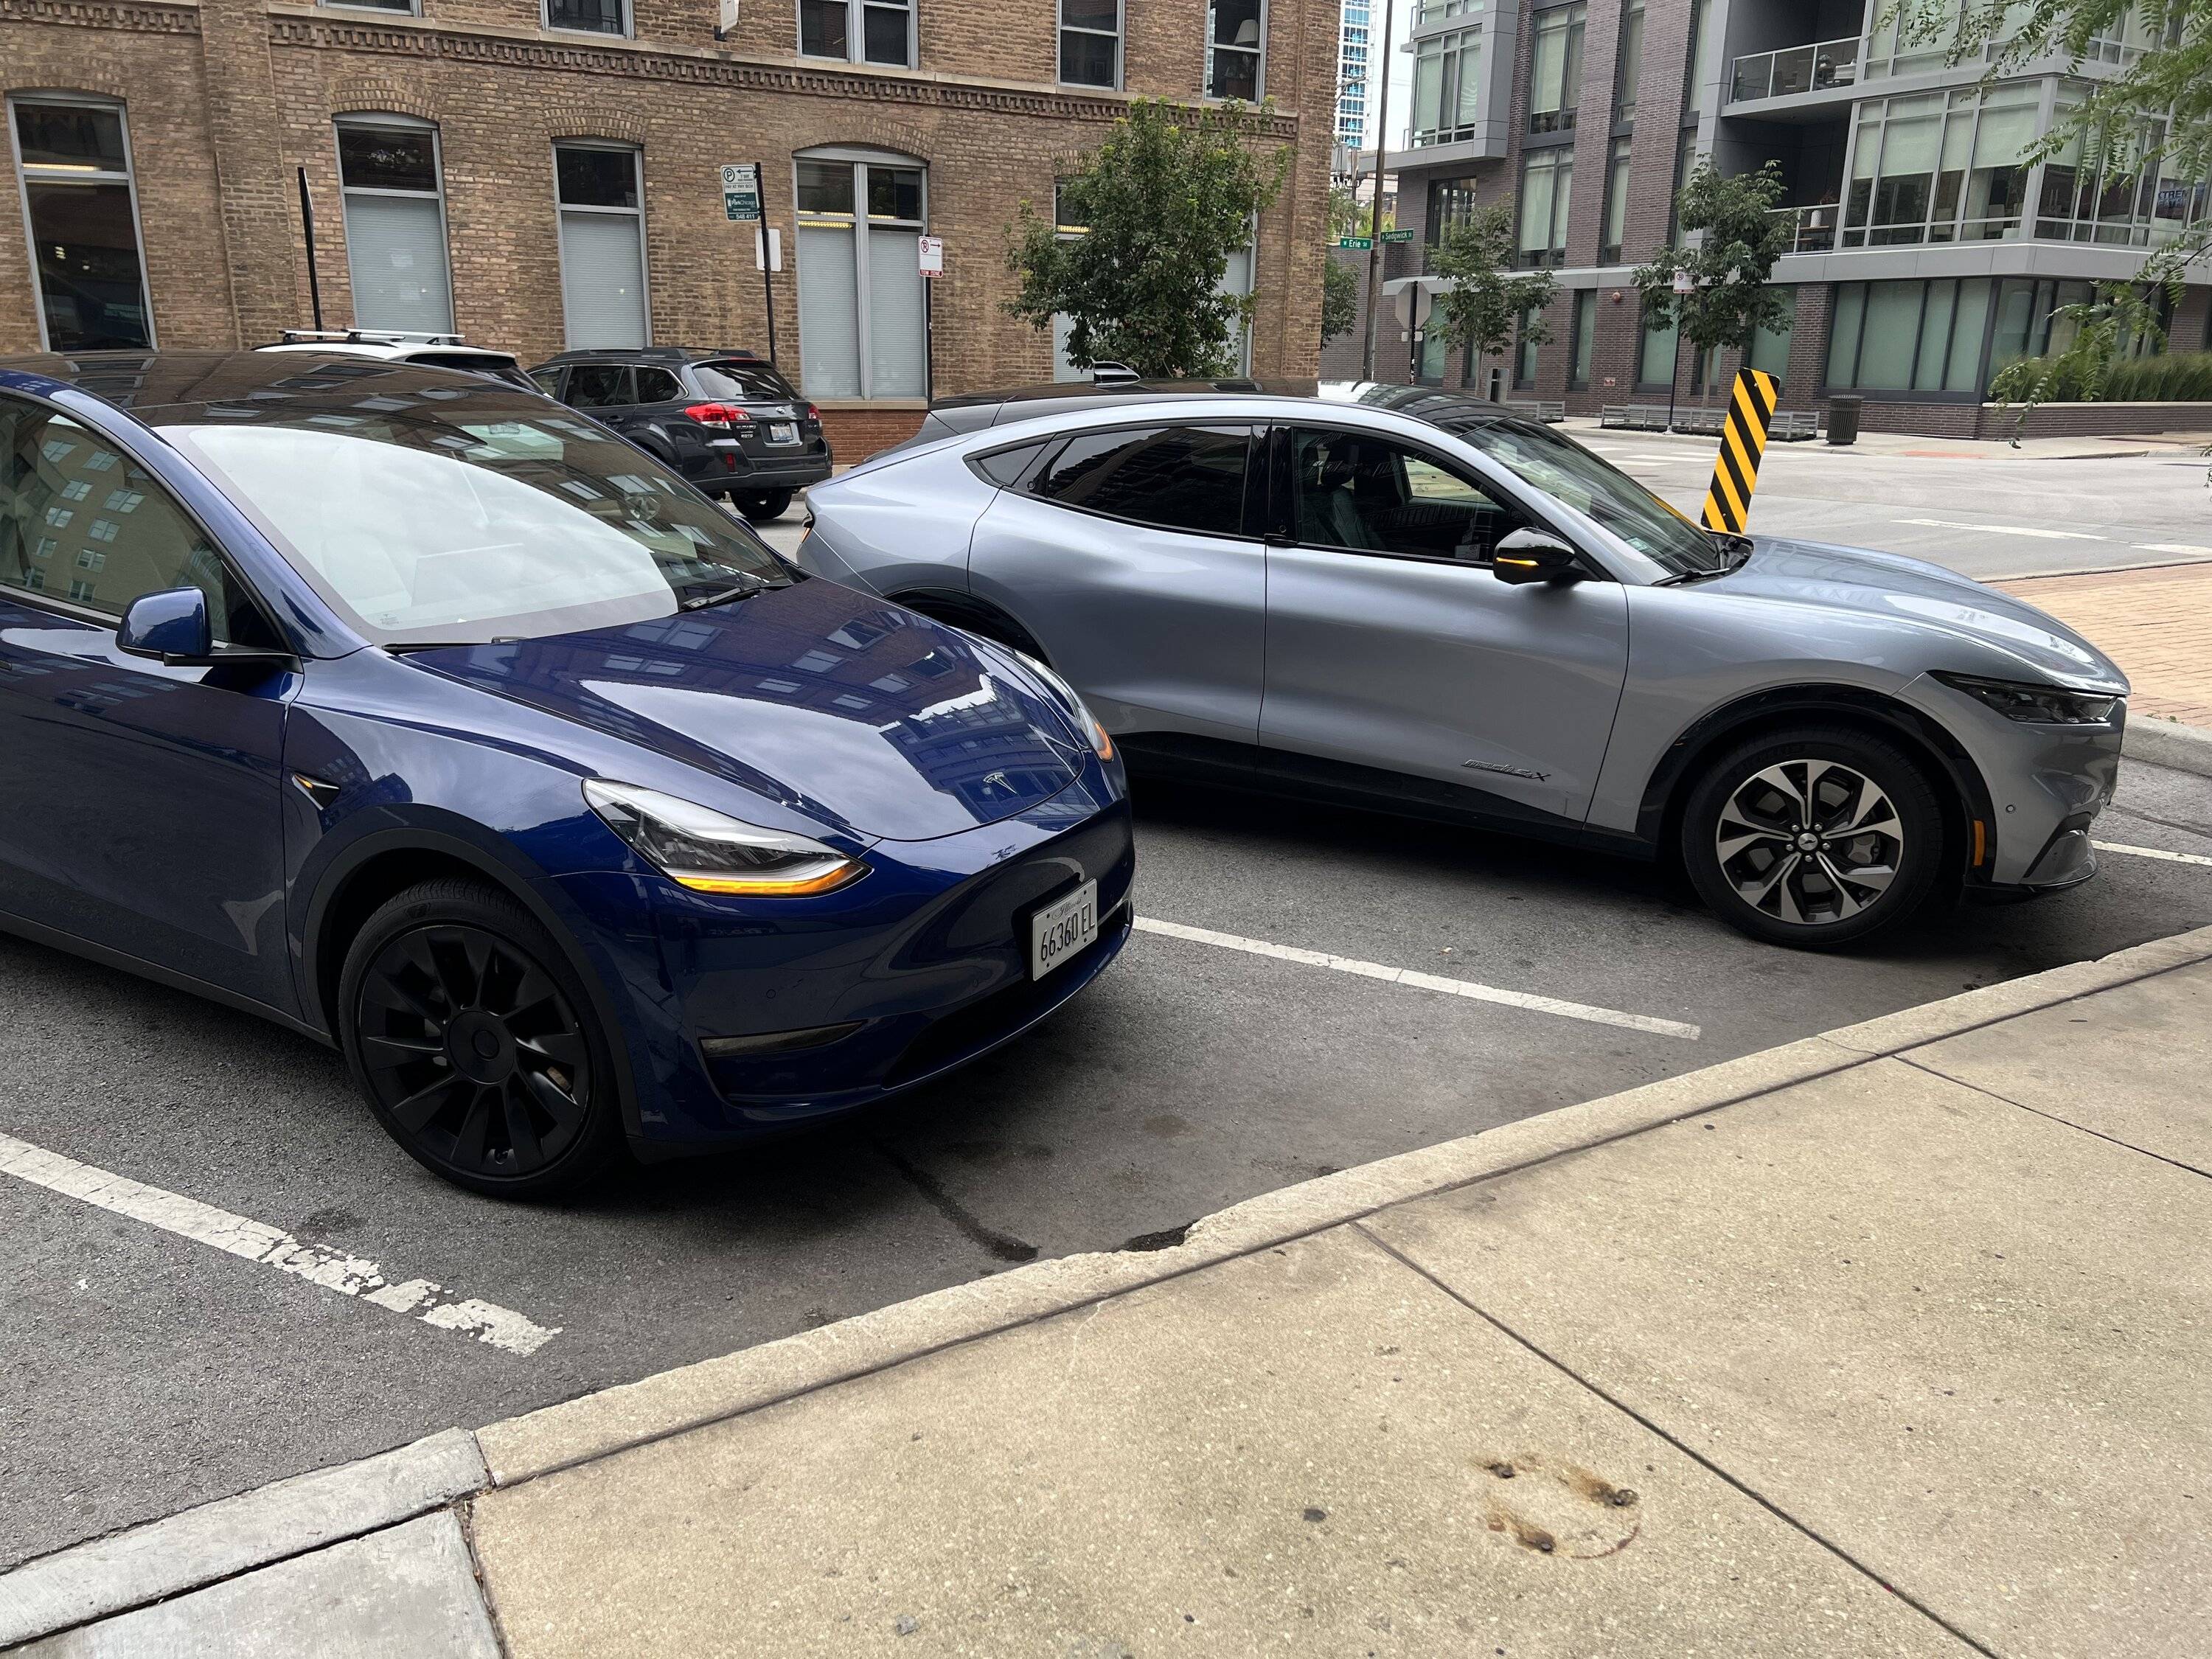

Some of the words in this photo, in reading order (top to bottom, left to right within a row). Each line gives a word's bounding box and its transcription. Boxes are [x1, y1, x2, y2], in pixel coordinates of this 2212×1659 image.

[1385, 231, 1408, 242] Sedgwick
[1349, 239, 1361, 248] Erie
[1040, 912, 1078, 961] 66360
[1082, 901, 1095, 935] EL
